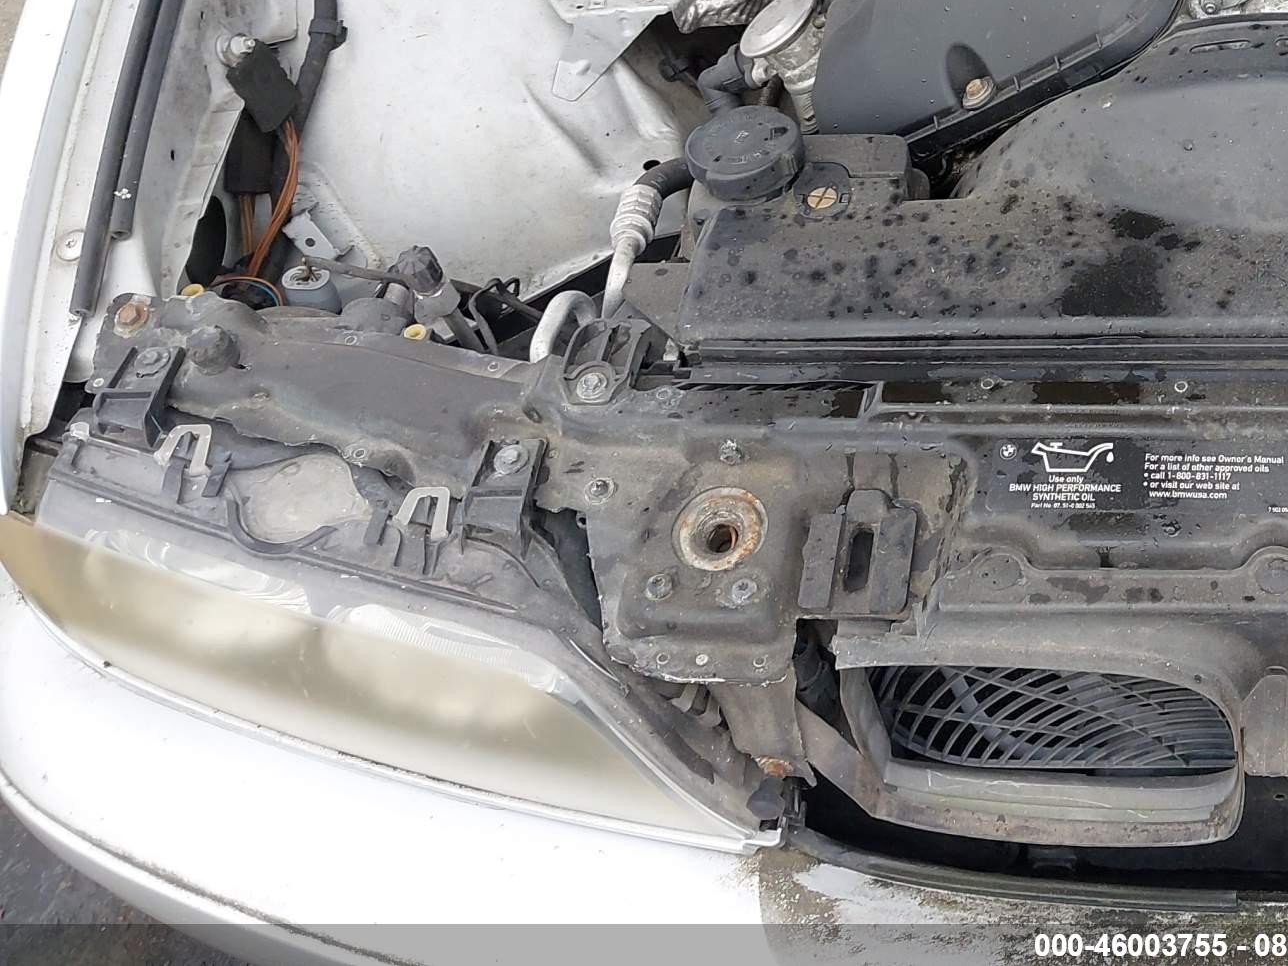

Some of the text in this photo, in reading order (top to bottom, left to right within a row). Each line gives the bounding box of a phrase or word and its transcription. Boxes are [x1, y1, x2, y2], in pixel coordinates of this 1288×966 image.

[1145, 453, 1159, 462] For
[1184, 454, 1200, 462] info
[1218, 454, 1252, 463] Owner's
[1254, 455, 1284, 464] Manual
[1144, 462, 1158, 470] For
[1167, 462, 1180, 471] list
[1182, 463, 1190, 471] of
[1192, 463, 1213, 471] other
[1215, 464, 1252, 474] approved
[1254, 464, 1270, 472] oils
[1048, 474, 1084, 484] Use only
[1168, 472, 1231, 480] 1-800-831-1117
[1009, 484, 1122, 492] BMW HIGH PERFORMANCE
[1160, 481, 1178, 489] visit
[1196, 482, 1213, 490] web
[1215, 482, 1230, 490] site
[1232, 483, 1240, 491] at
[1032, 493, 1096, 501] SYNTHETIC OIL
[1149, 491, 1227, 499] www.bmwusa.com
